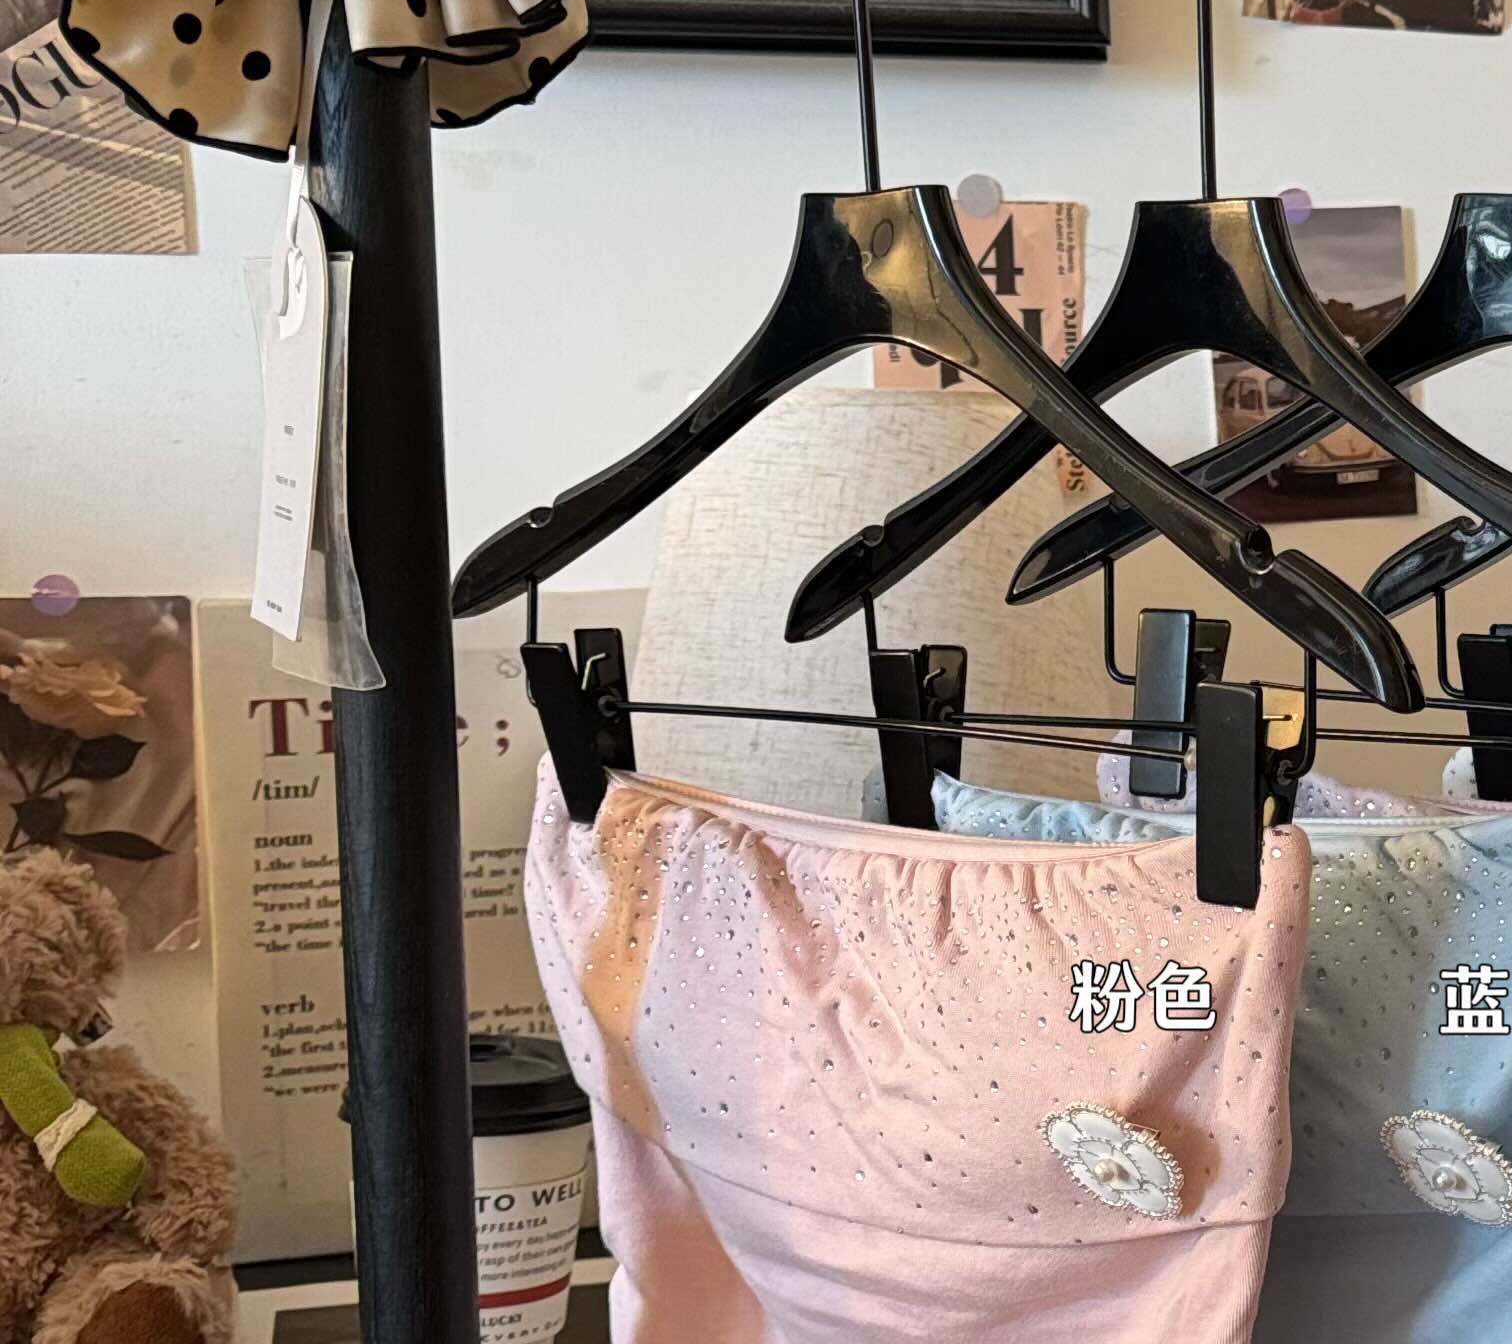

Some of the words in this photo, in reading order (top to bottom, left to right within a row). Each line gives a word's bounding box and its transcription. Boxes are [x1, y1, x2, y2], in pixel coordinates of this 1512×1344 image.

[977, 214, 1024, 296] 4
[1061, 297, 1078, 366] ource
[252, 776, 320, 801] /tim/
[254, 833, 313, 849] noun
[261, 994, 316, 1016] verb
[475, 1194, 515, 1213] TO
